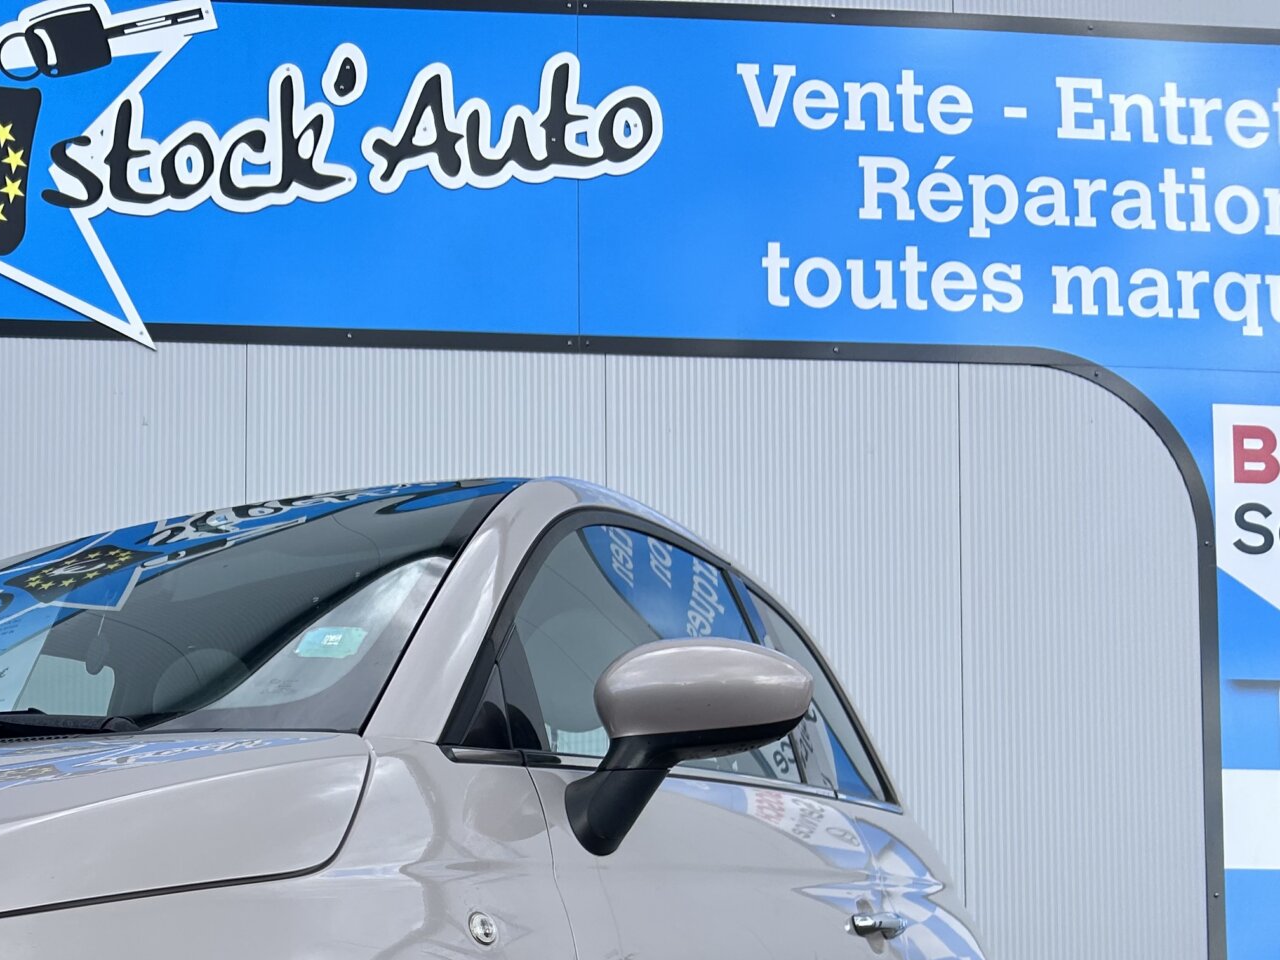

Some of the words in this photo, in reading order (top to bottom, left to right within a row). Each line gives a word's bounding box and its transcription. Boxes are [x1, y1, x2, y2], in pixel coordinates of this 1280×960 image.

[736, 63, 973, 136] Vente
[1003, 107, 1027, 119] -
[761, 242, 1024, 313] toutes
